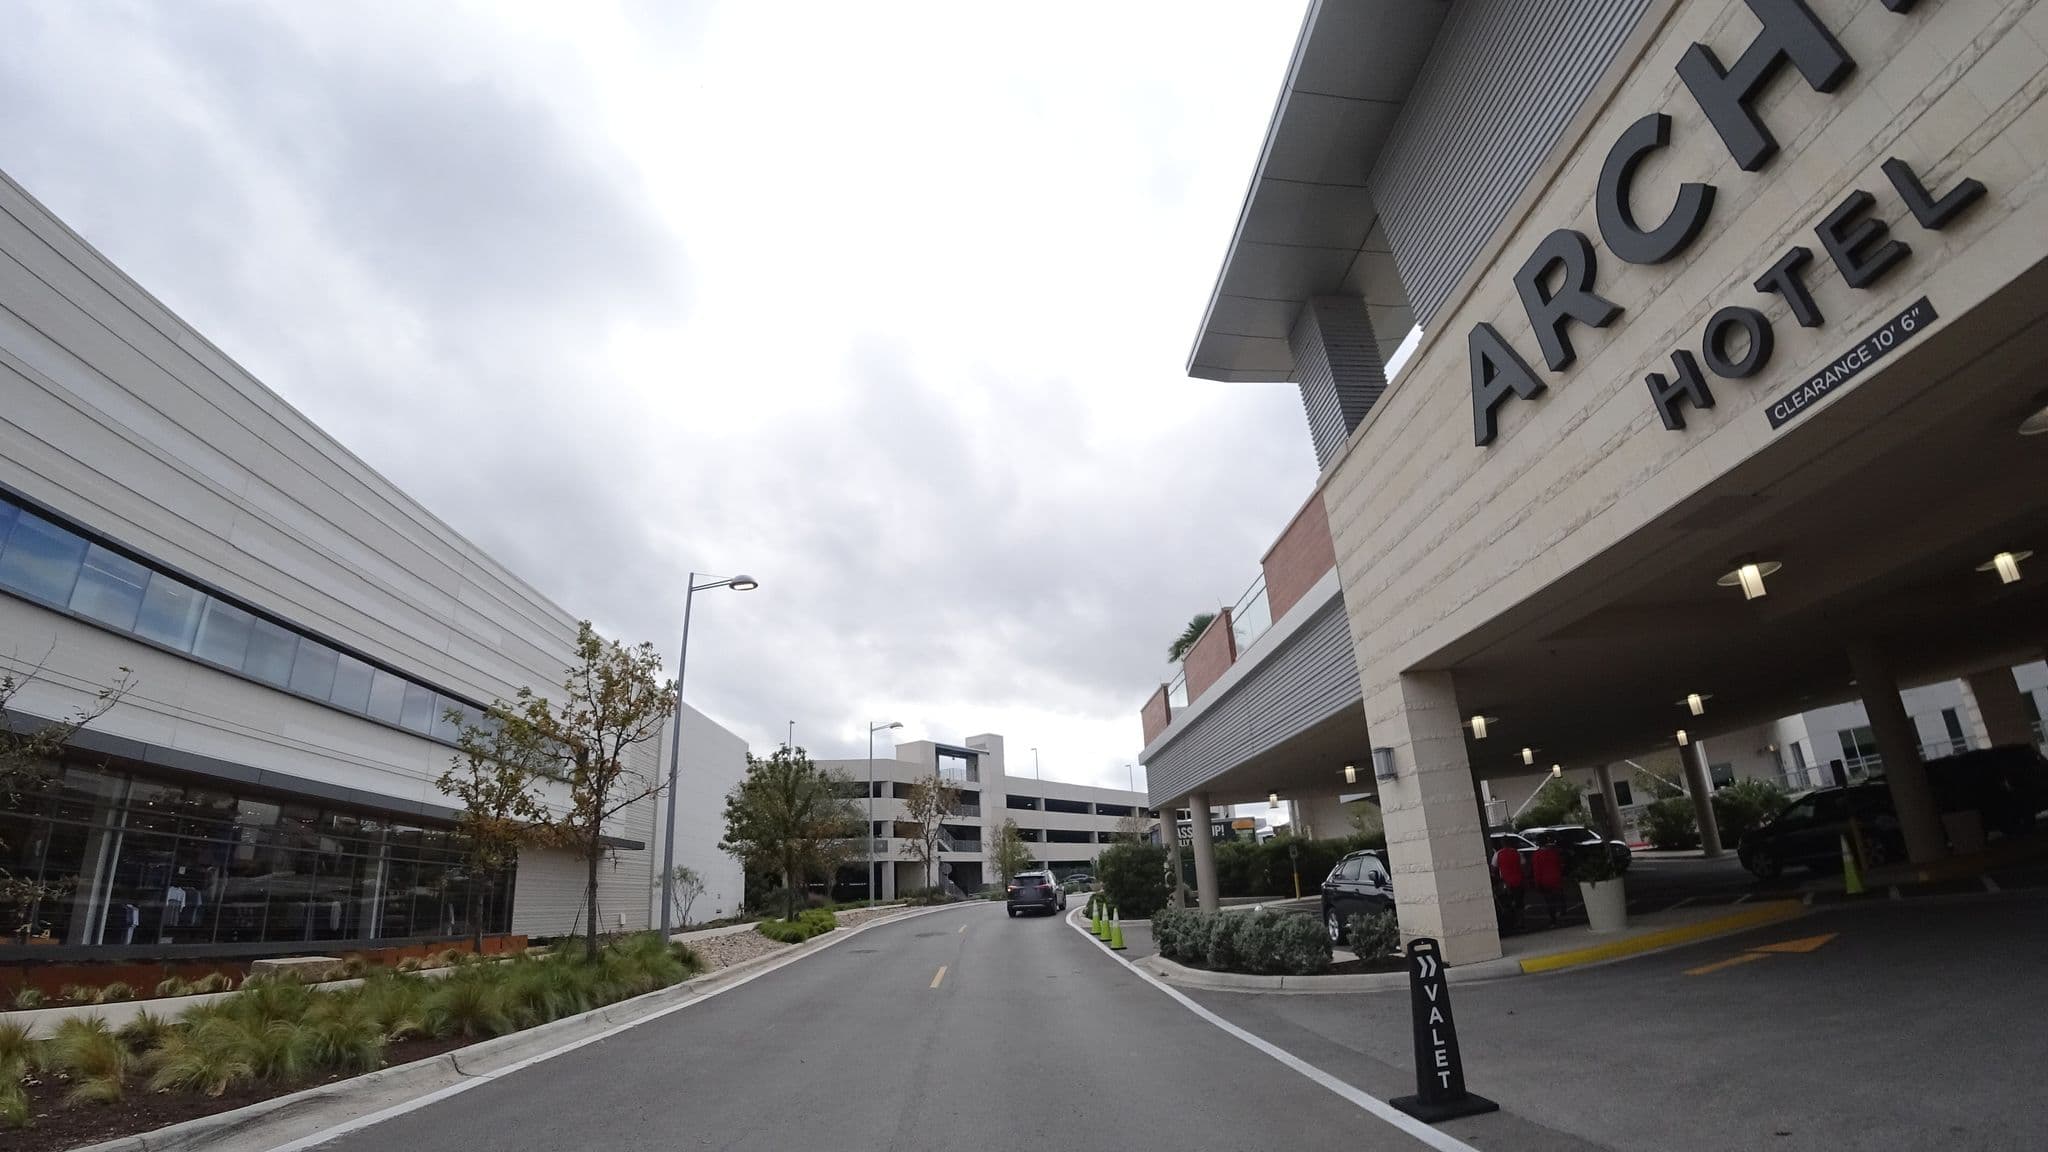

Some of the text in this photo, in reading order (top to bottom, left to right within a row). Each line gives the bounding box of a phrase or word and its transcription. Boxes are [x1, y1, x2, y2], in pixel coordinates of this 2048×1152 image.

[1467, 0, 1917, 447] ARCH
[1645, 157, 1988, 430] HOTEL
[1774, 345, 1872, 419] CLEARANCE
[1872, 325, 1895, 351] 10'
[1424, 983, 1451, 1089] VALET
